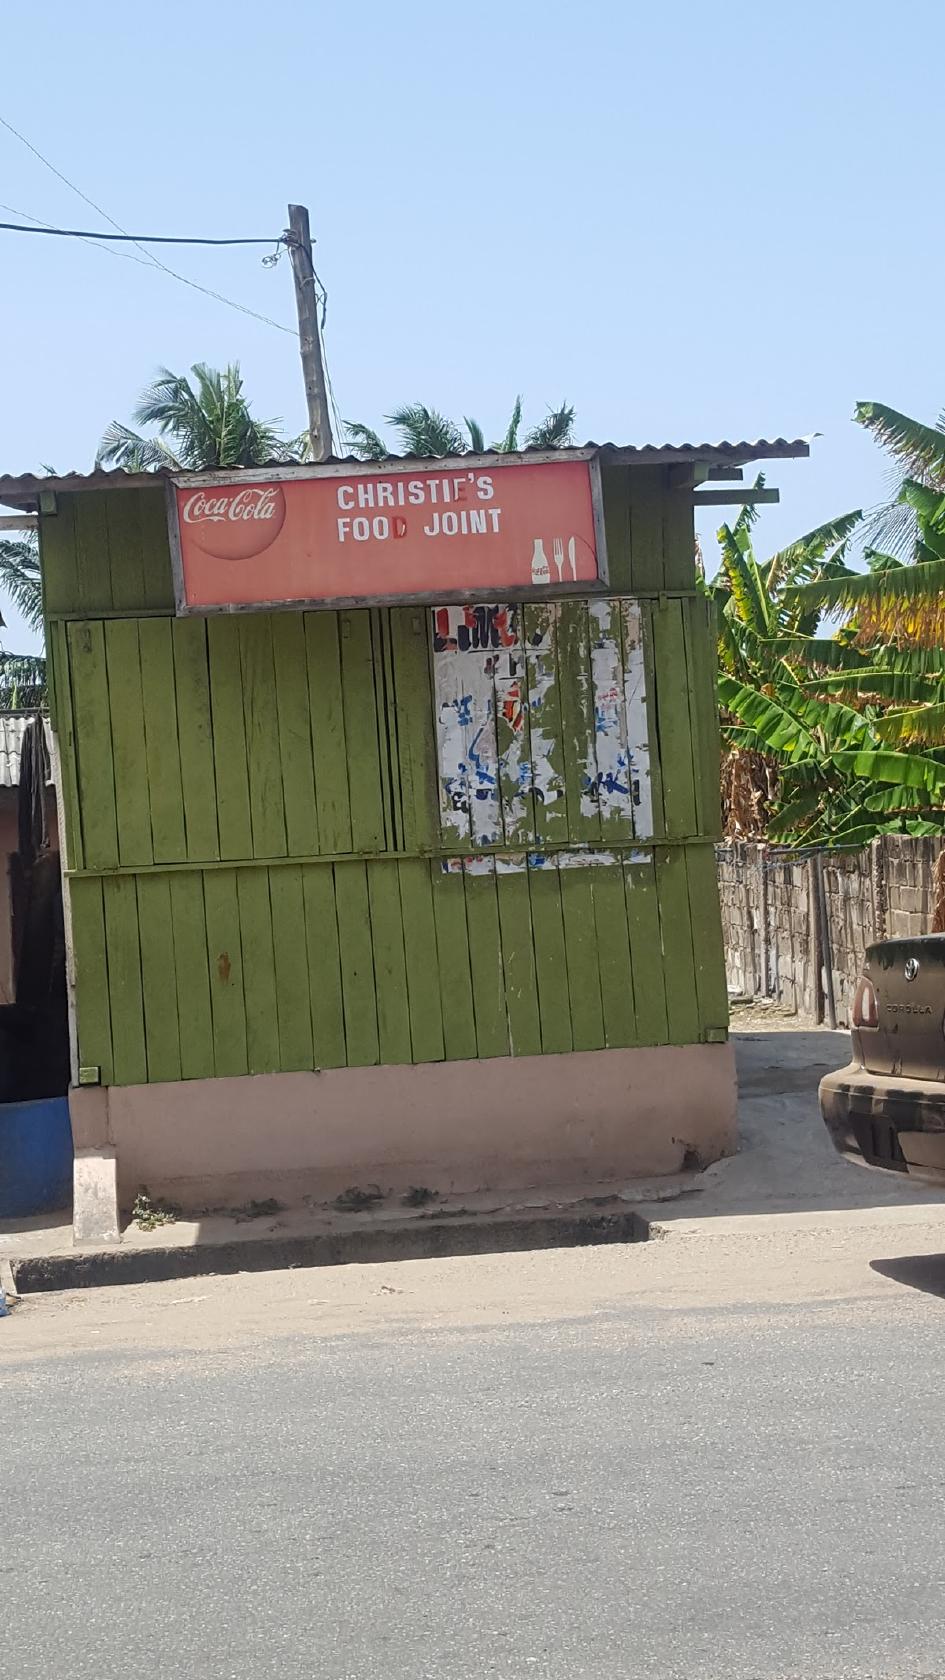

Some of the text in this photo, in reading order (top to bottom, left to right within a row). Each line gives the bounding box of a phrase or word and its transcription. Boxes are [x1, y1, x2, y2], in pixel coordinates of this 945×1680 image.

[337, 473, 494, 510] CHRISTIE'S
[337, 508, 502, 542] FOOD JOINT
[886, 1003, 932, 1015] COROLLA
